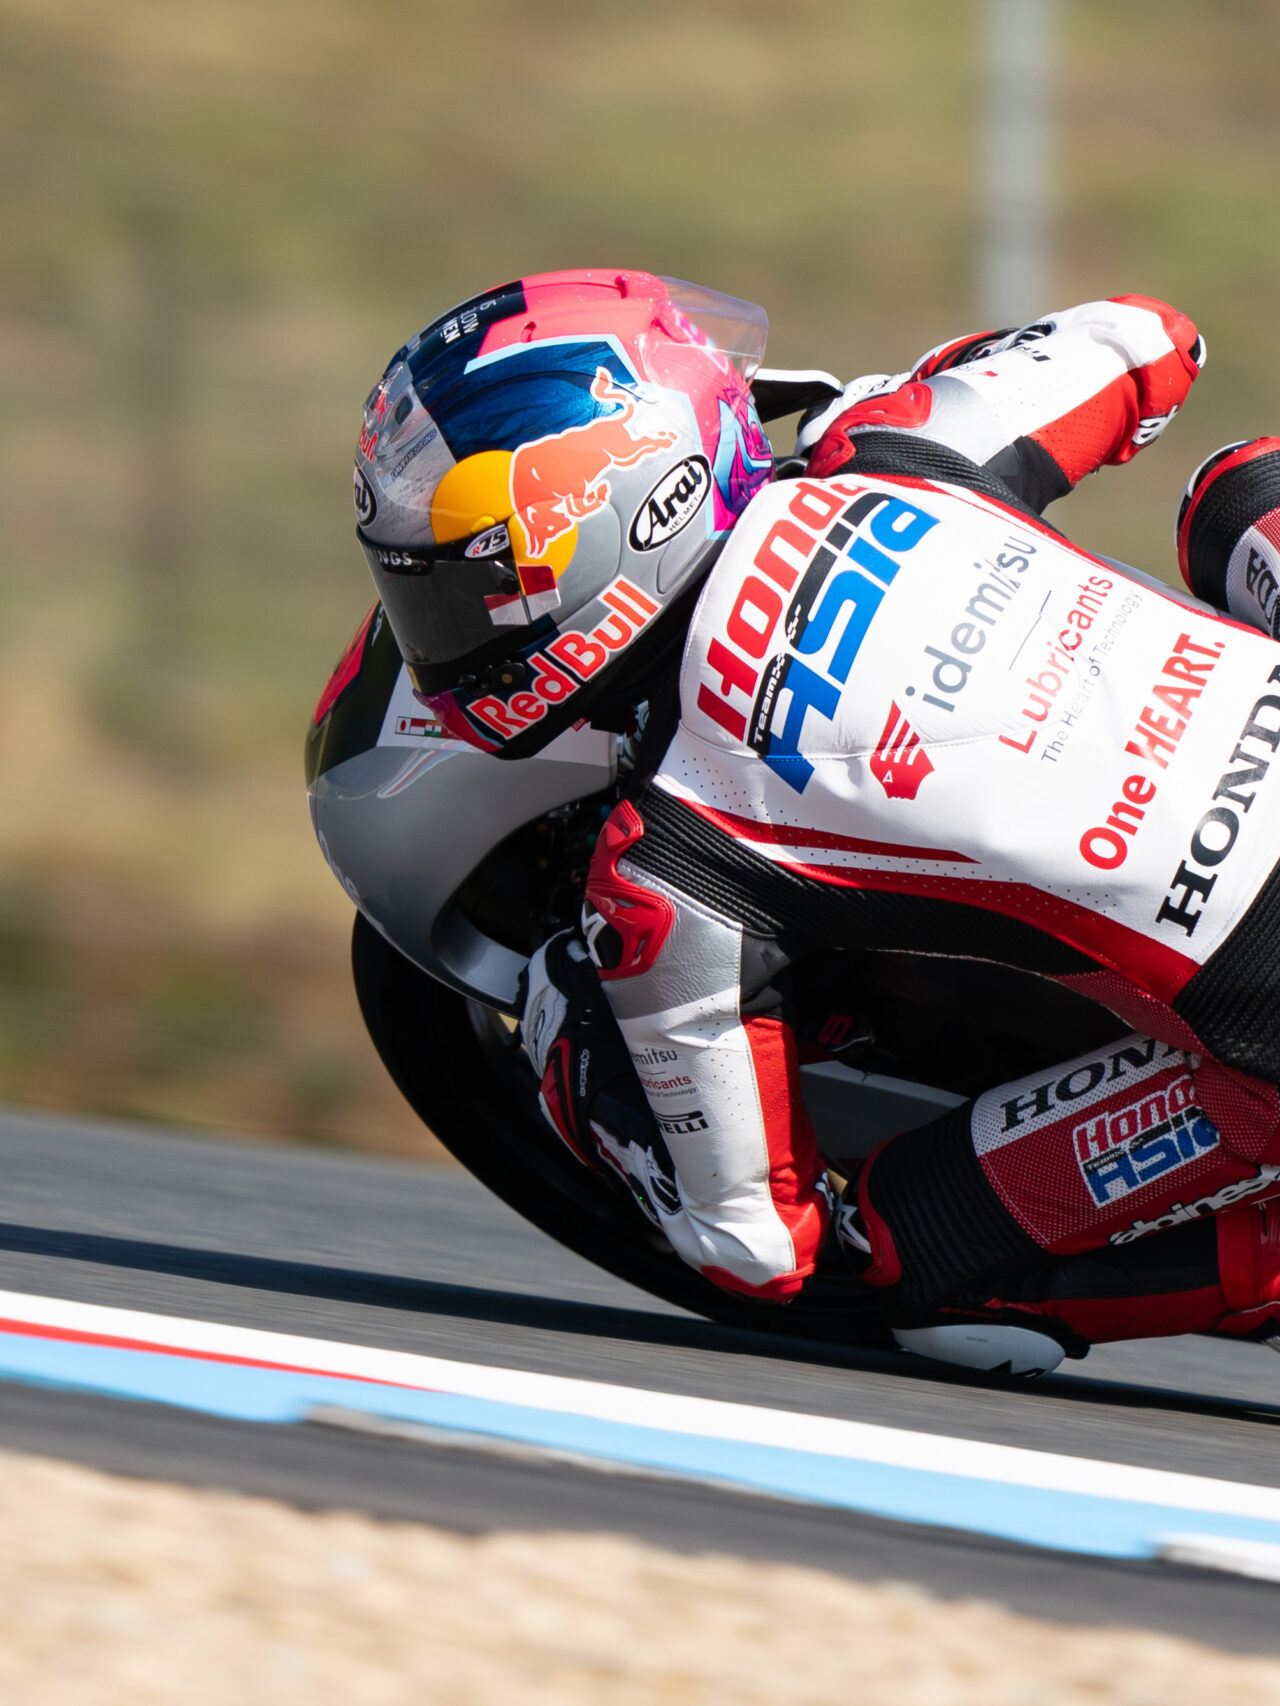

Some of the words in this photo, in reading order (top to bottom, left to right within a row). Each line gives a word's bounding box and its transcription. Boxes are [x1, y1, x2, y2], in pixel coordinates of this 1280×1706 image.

[643, 460, 703, 549] Arai
[468, 653, 579, 739] Red
[548, 577, 661, 680] Bull
[905, 536, 1038, 712] idemitsu
[998, 575, 1114, 754] Lubricants
[1041, 733, 1065, 763] The
[1093, 589, 1144, 656] Technology
[1079, 774, 1157, 871] One
